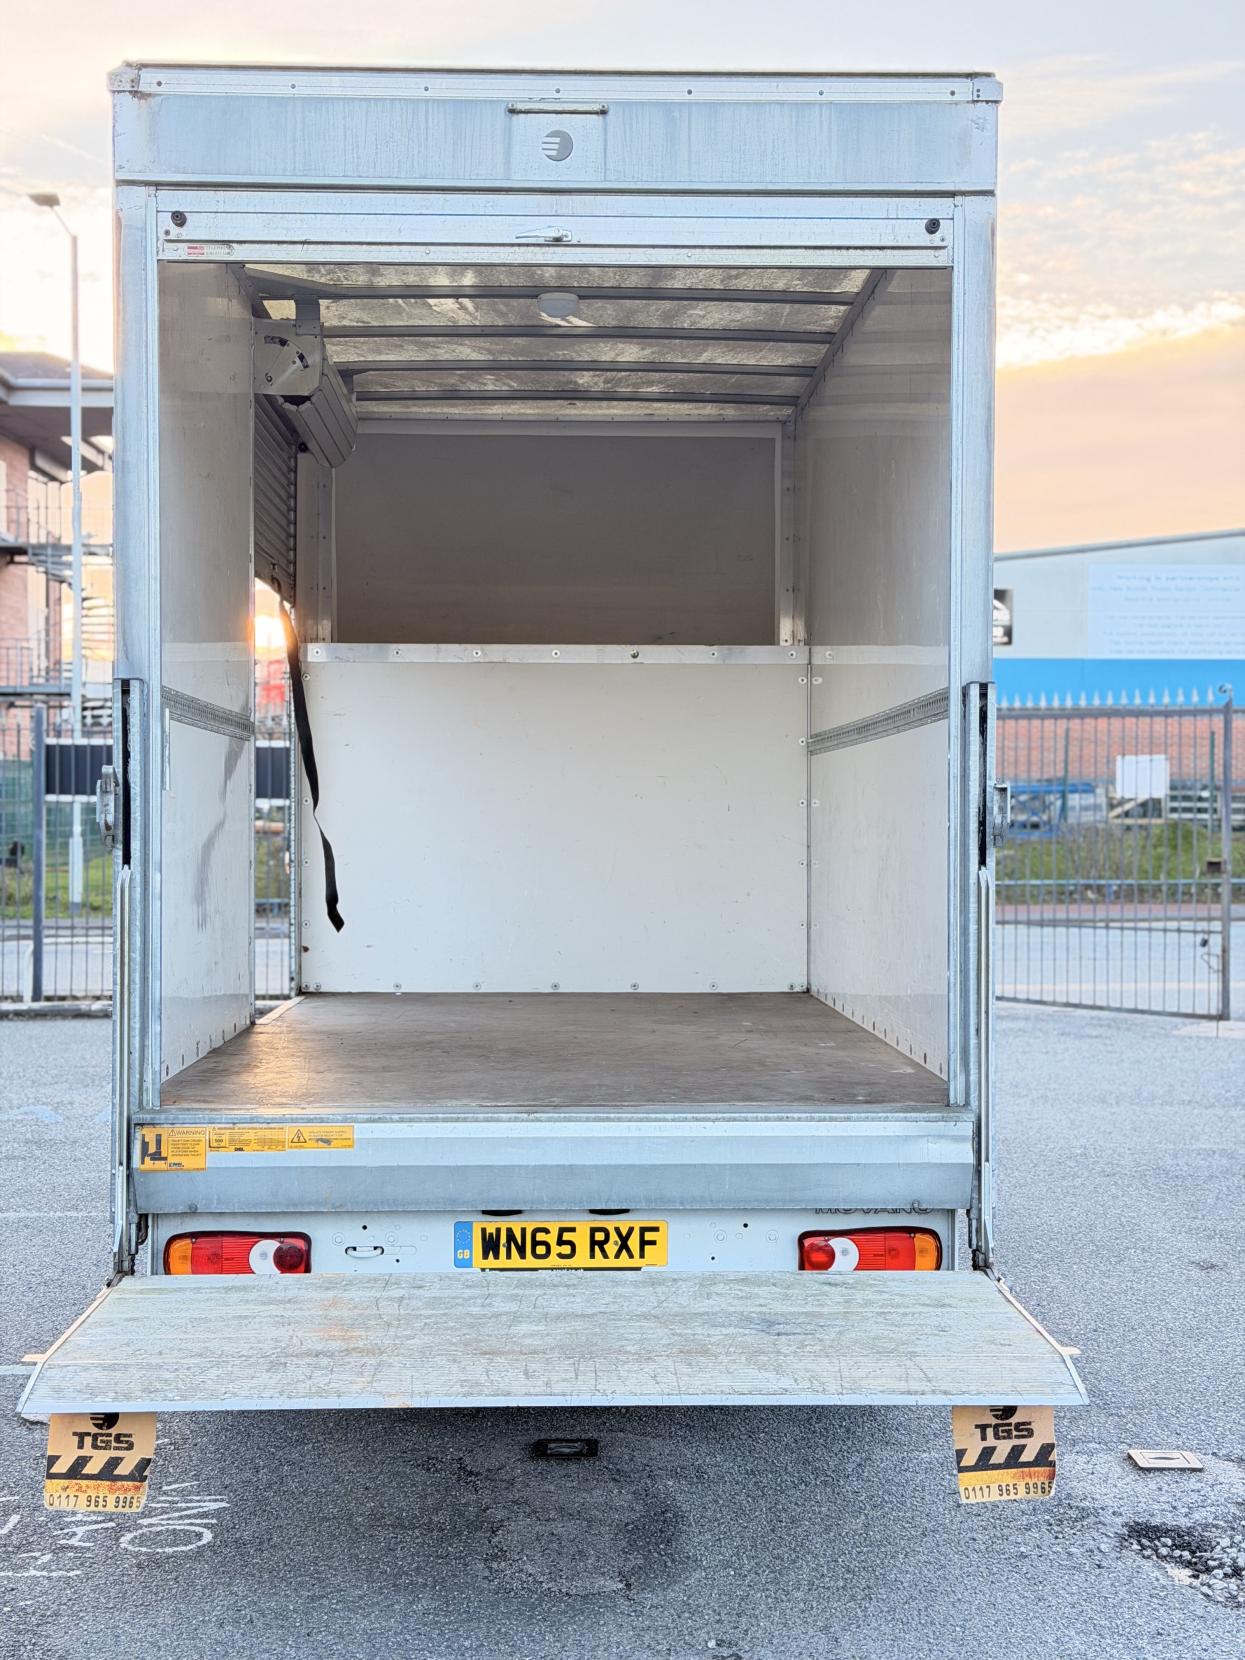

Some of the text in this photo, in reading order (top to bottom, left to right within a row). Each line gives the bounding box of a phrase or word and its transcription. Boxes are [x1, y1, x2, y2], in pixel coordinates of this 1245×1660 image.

[480, 1226, 660, 1260] WN65 RXF
[974, 1421, 1034, 1441] TGS
[72, 1431, 135, 1452] TGS
[964, 1481, 1052, 1499] 0117 965 9965
[48, 1493, 142, 1509] 0117 965 9965
